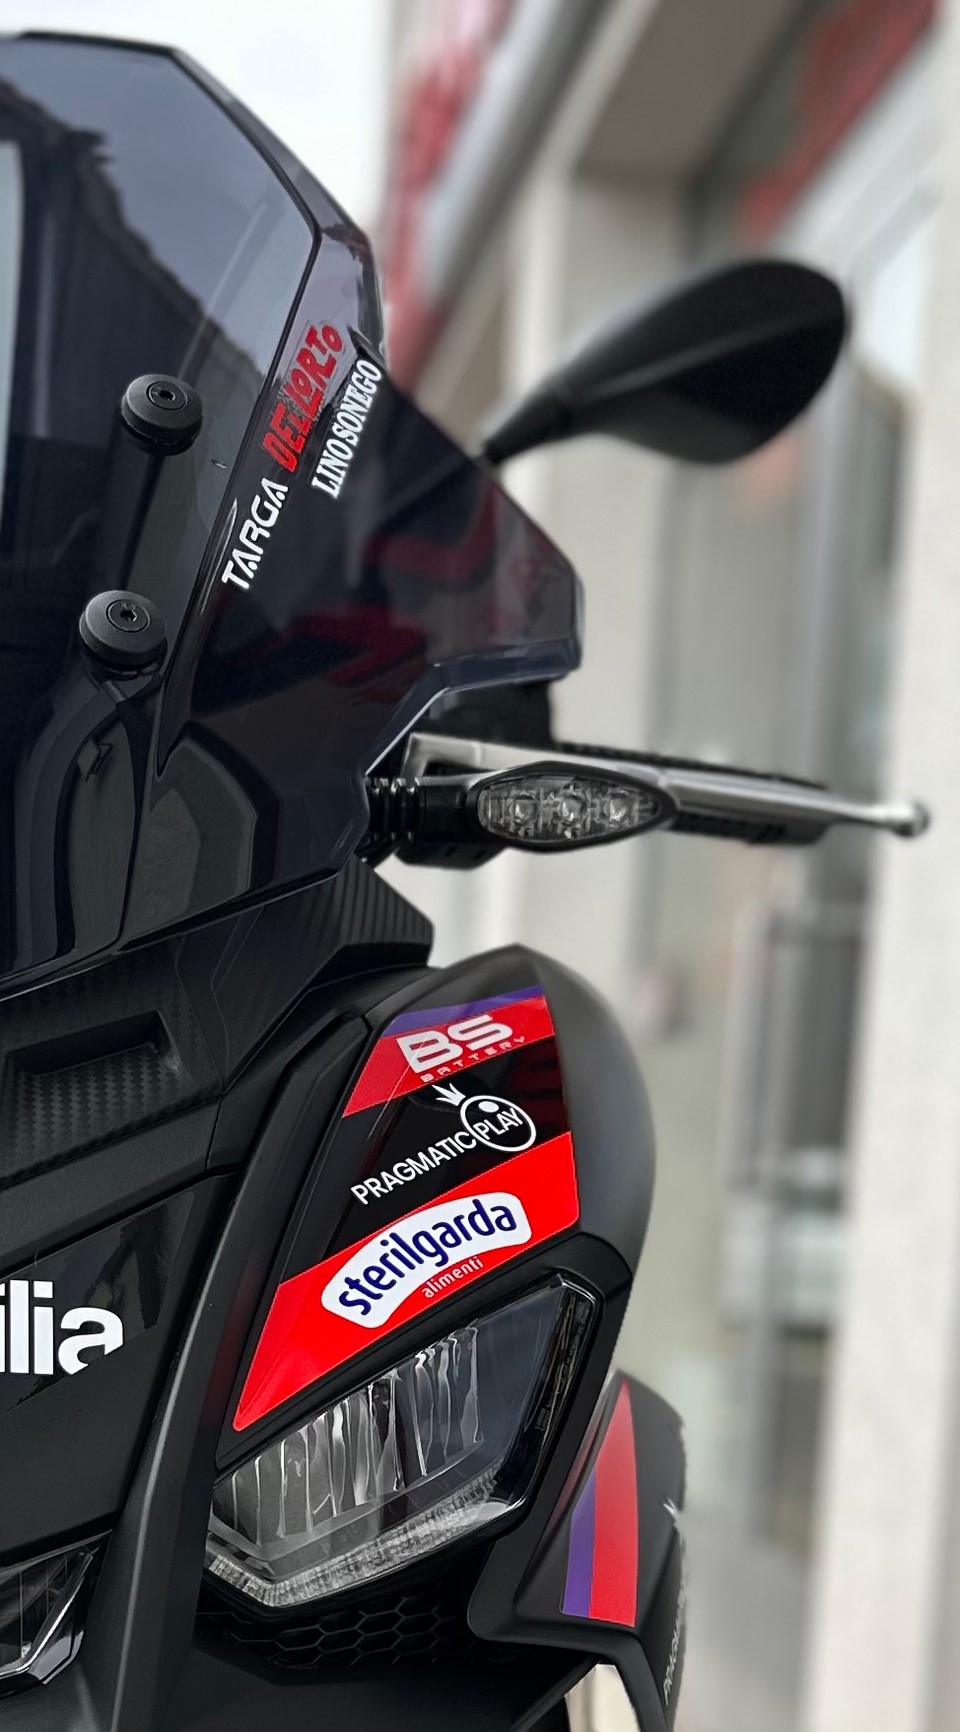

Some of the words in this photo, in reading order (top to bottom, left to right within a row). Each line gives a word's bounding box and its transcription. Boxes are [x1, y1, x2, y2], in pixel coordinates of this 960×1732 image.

[311, 438, 350, 499] LINO
[331, 360, 383, 447] SONEGO
[221, 477, 289, 589] TARGA
[396, 1014, 513, 1074] BS
[420, 1036, 525, 1083] BATTERY
[350, 1130, 478, 1205] PRAGMATIC
[472, 1108, 525, 1141] PLAY
[339, 1198, 518, 1316] sterilgarda
[421, 1256, 484, 1299] alimenti
